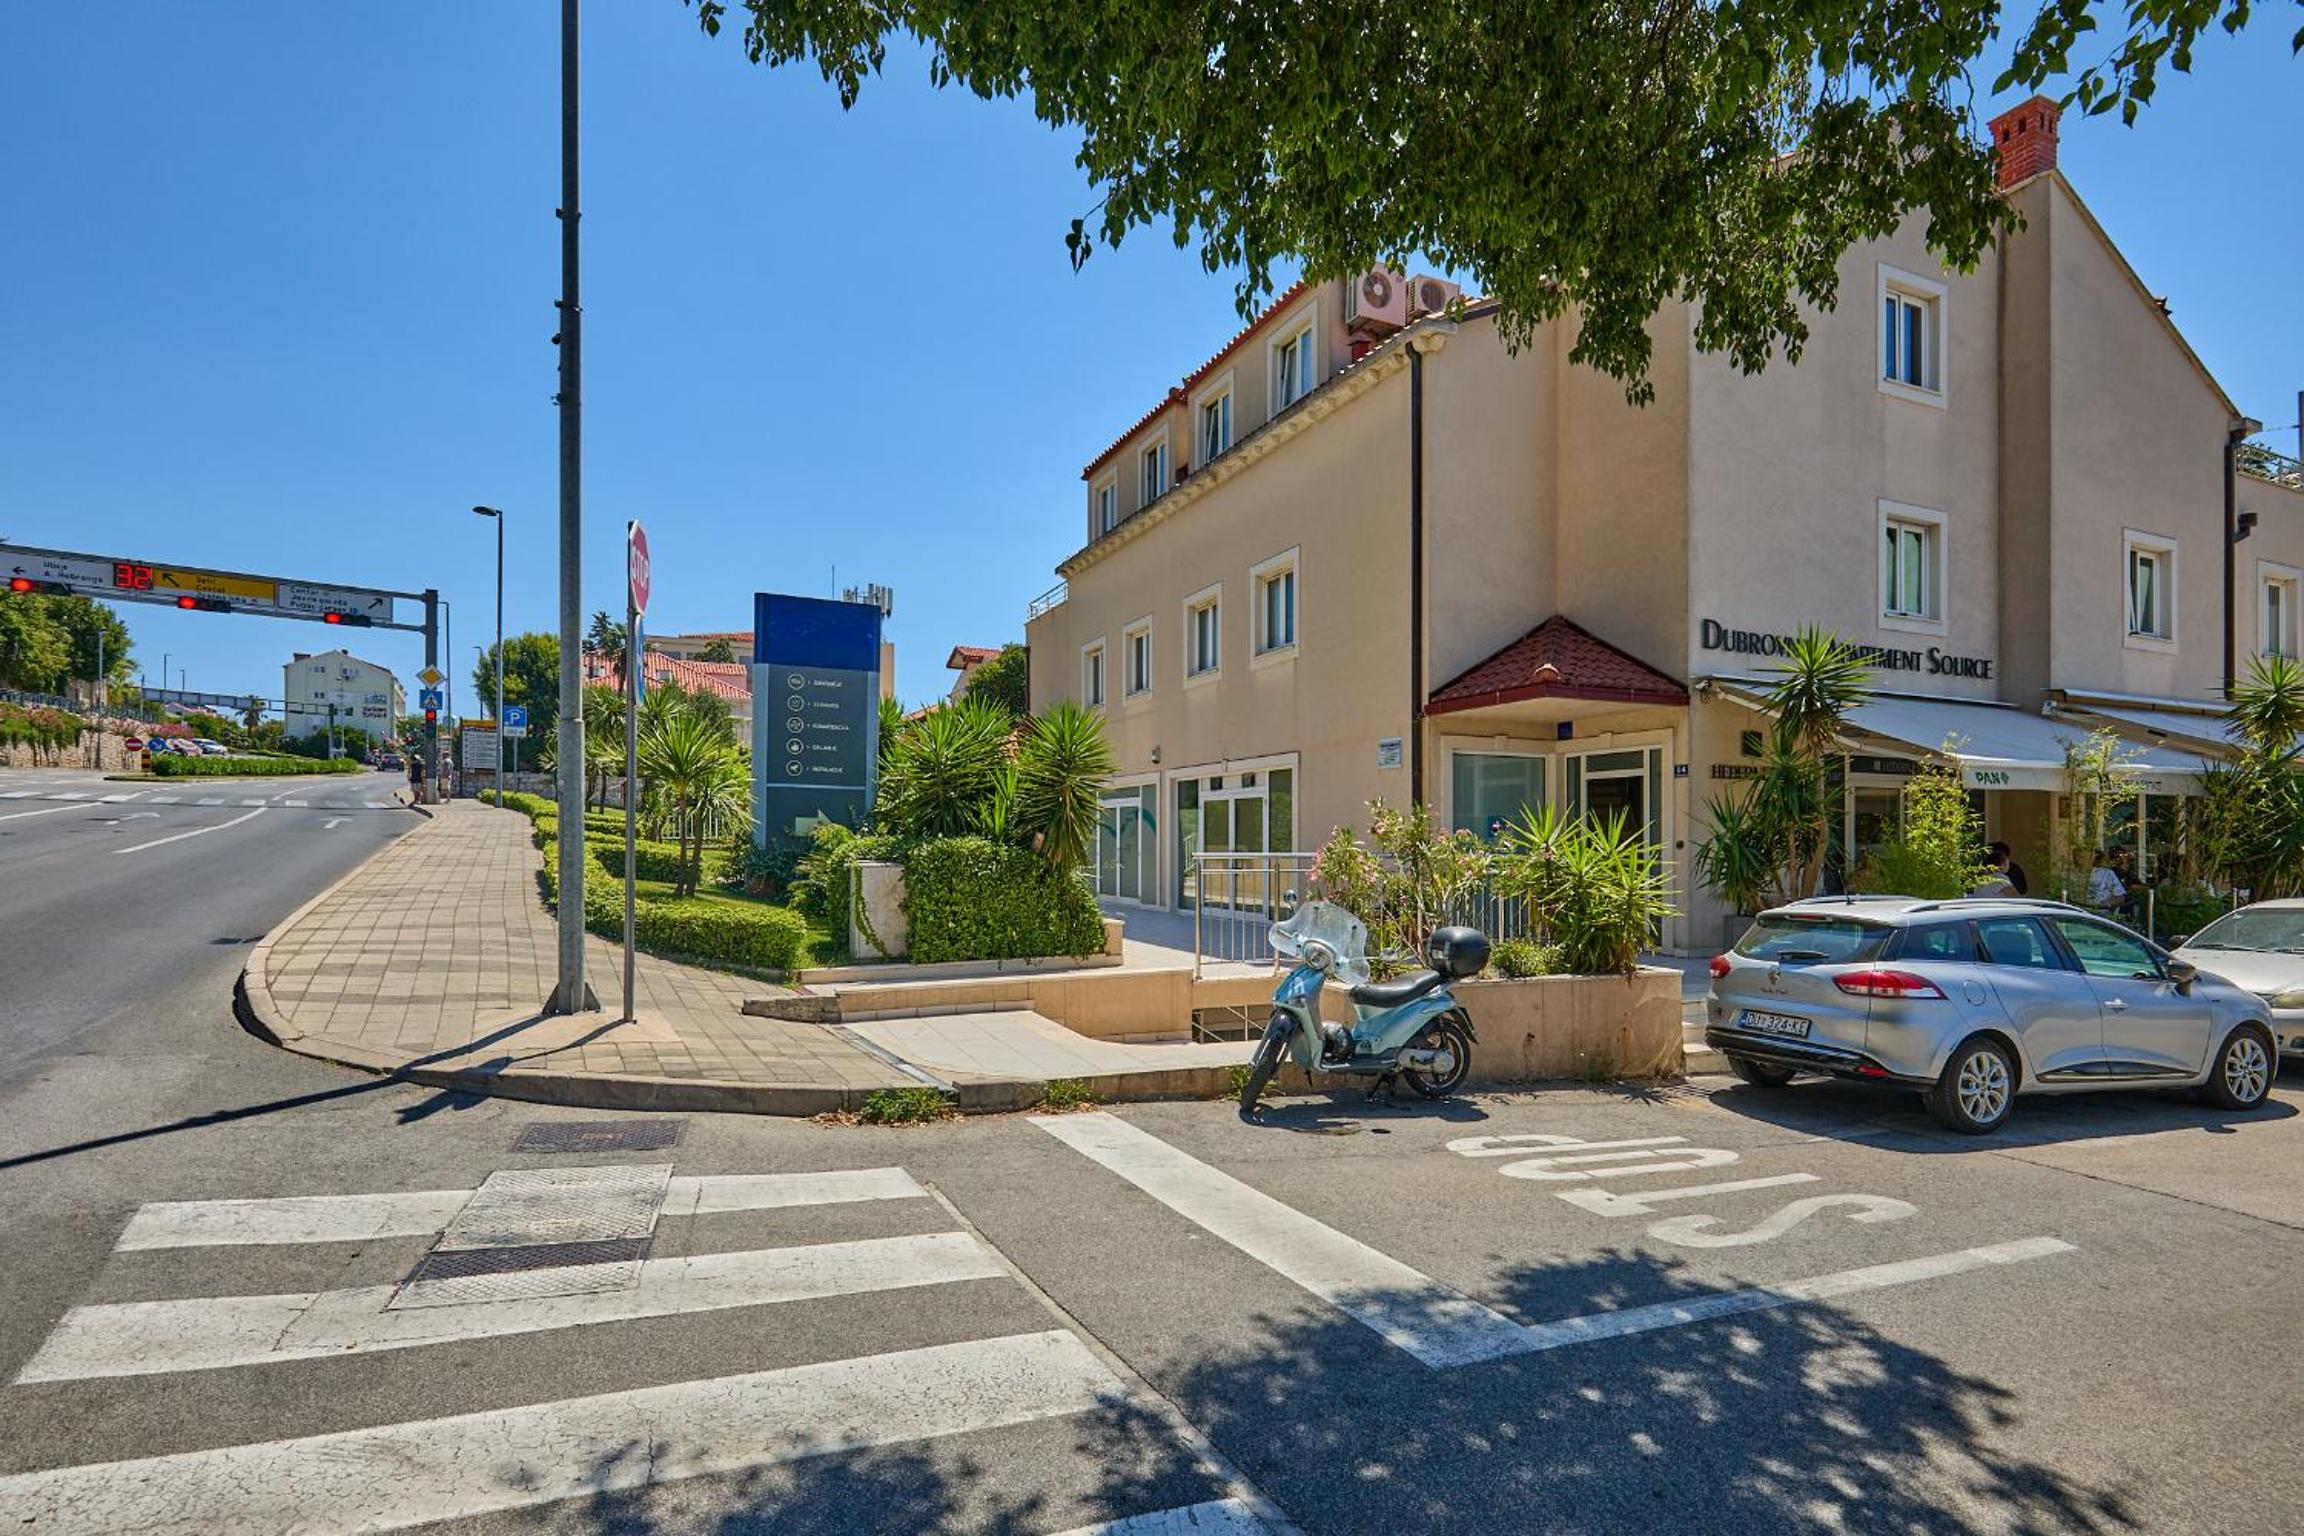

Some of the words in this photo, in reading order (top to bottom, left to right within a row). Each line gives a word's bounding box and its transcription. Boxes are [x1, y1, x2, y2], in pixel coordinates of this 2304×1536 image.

[1701, 618, 1811, 659] DUBROVN
[1927, 646, 1994, 680] SOURCE
[1446, 1134, 1919, 1248] STOP
